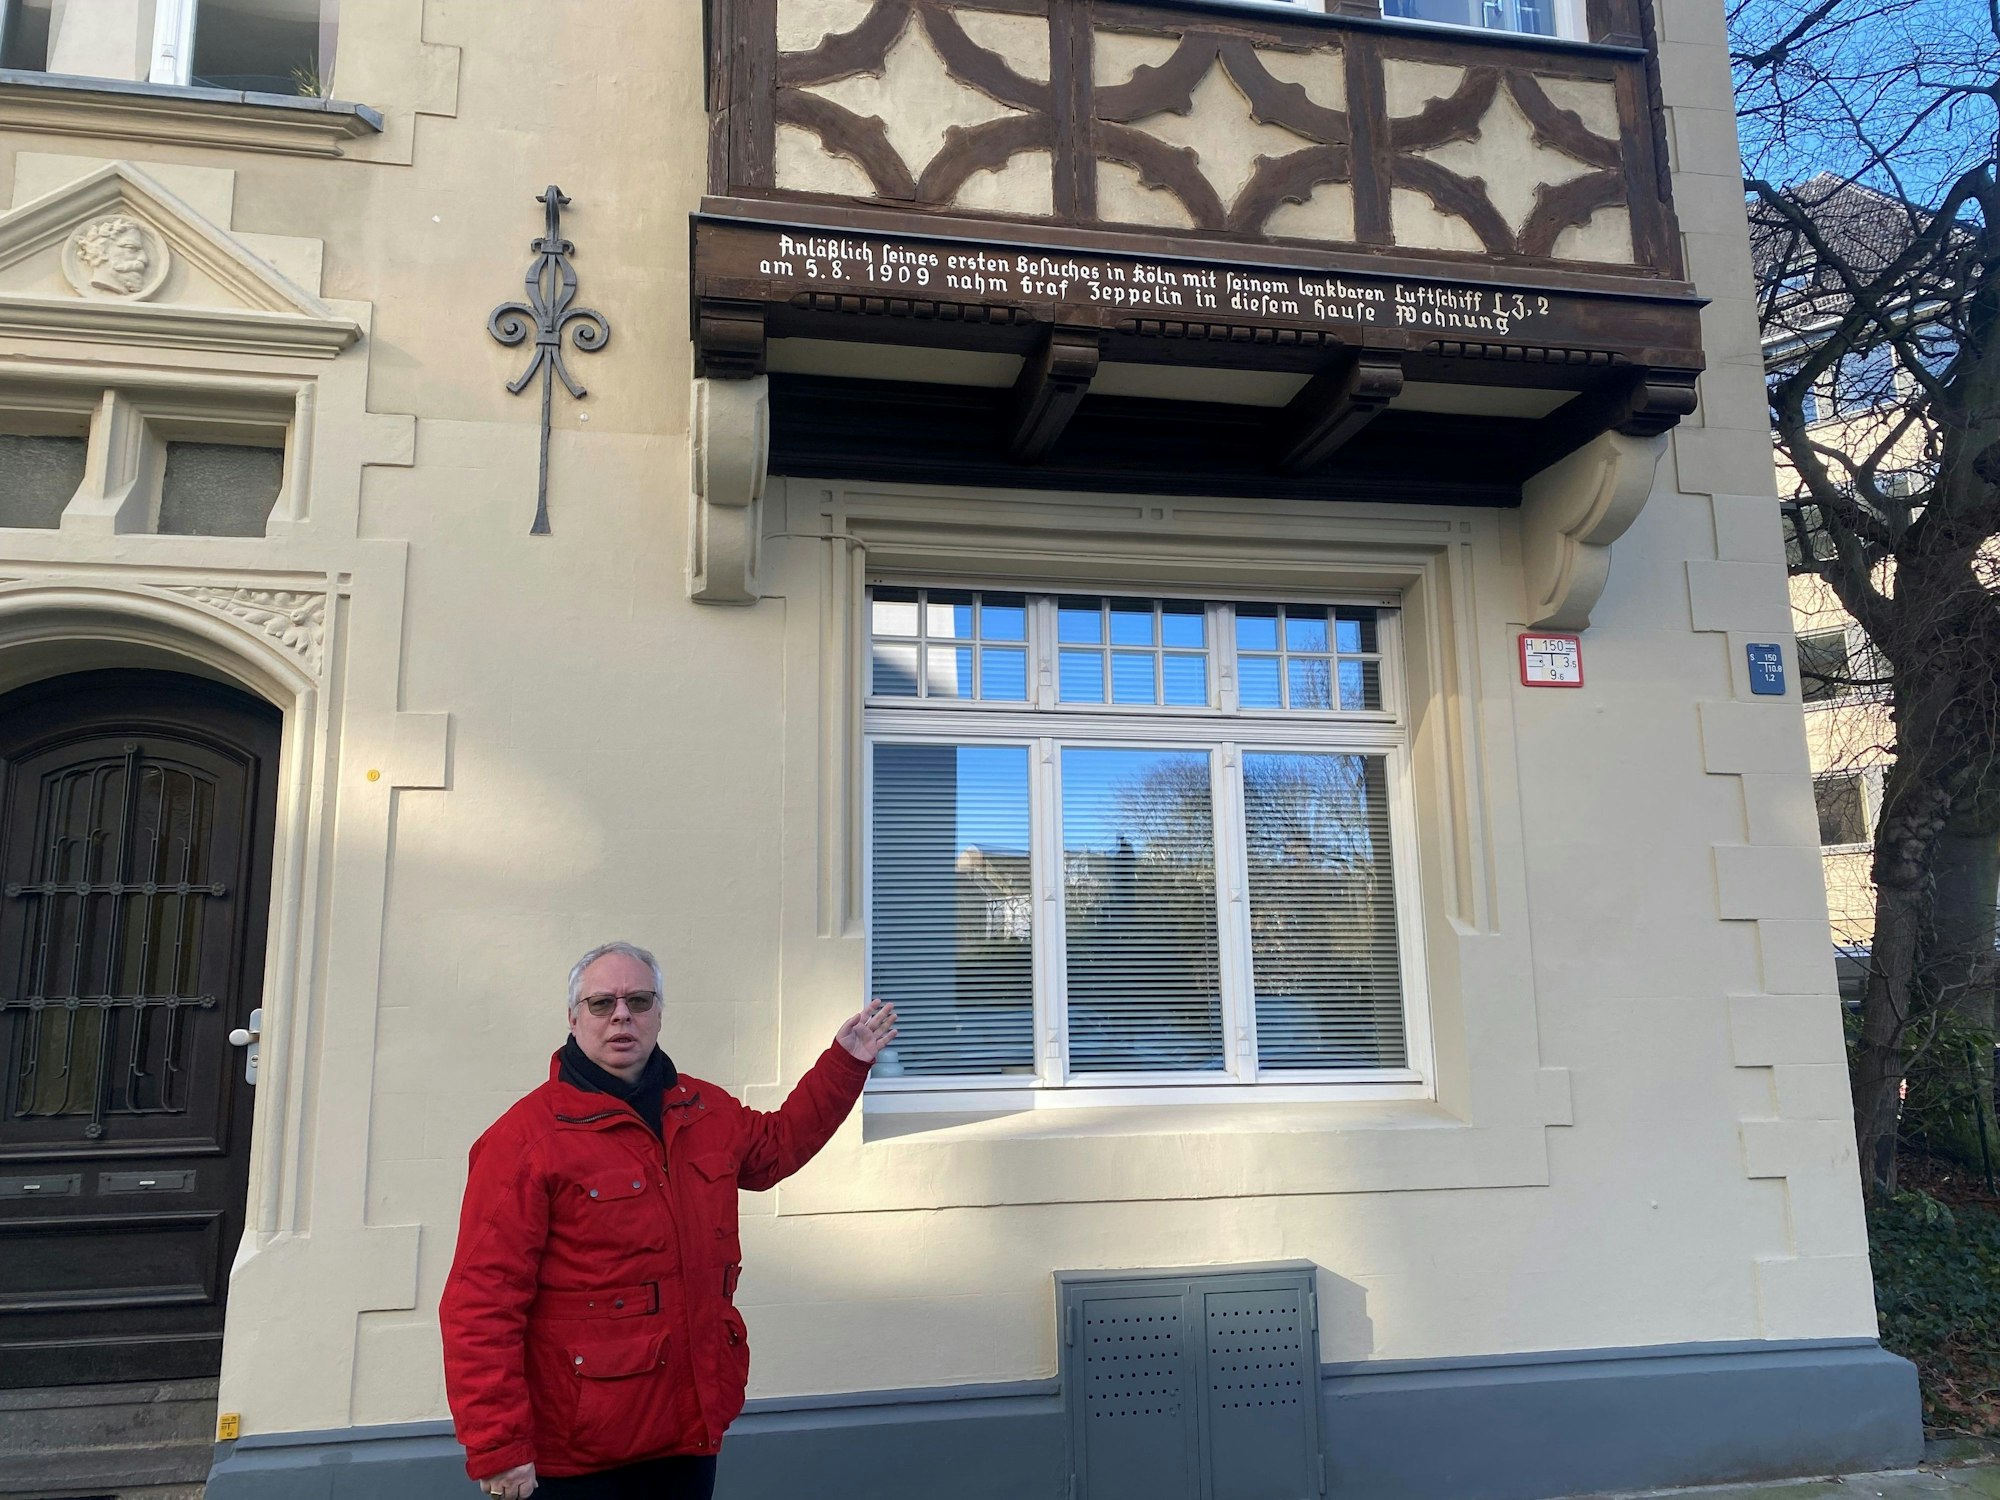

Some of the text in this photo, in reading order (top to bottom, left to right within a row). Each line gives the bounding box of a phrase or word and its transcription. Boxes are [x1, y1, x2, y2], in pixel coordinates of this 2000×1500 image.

[947, 251, 1010, 272] ersten
[1107, 263, 1126, 282] in
[1132, 263, 1178, 286] Köln
[1182, 270, 1217, 288] mit
[1298, 277, 1385, 302] lenkbaren
[760, 259, 794, 276] am
[866, 263, 930, 286] 1909
[946, 272, 1008, 294] nahm
[1020, 275, 1068, 300] Graf
[1087, 281, 1183, 306] Zeppelin
[1195, 289, 1217, 308] in
[1396, 304, 1510, 335] Wohnung
[1525, 640, 1564, 651] H 150
[1749, 653, 1777, 662] S 150
[1768, 665, 1783, 673] 10.8
